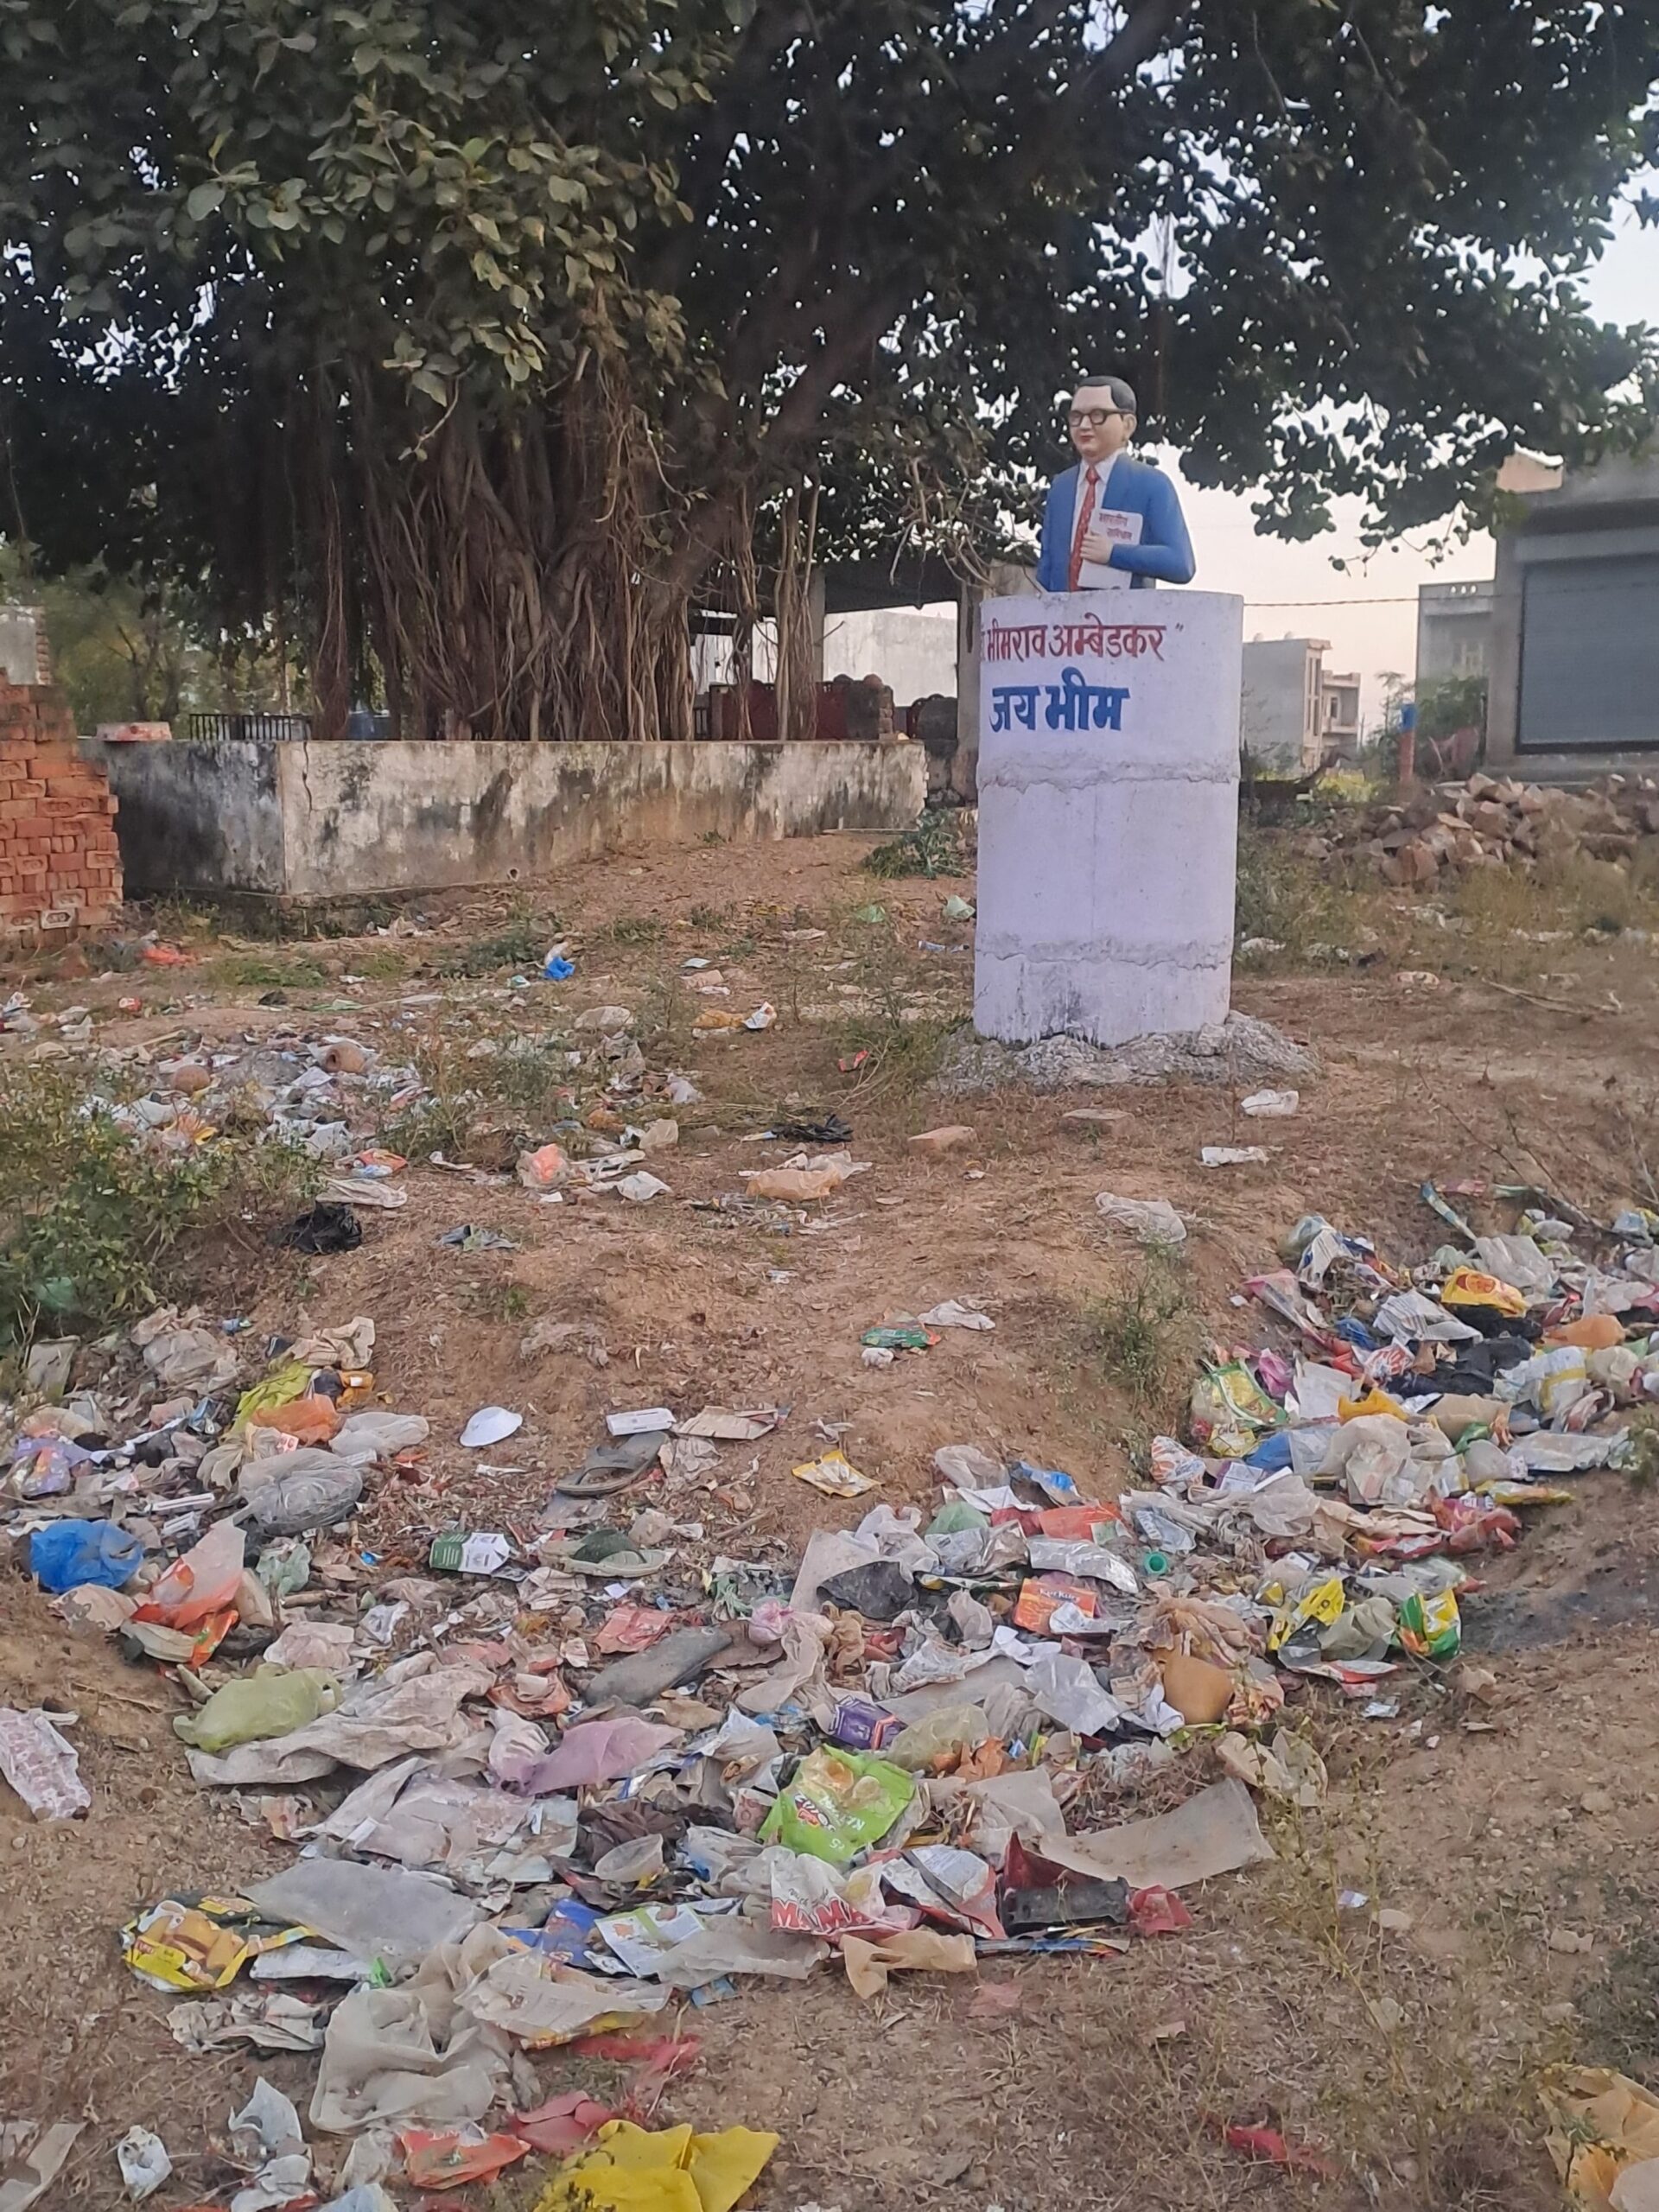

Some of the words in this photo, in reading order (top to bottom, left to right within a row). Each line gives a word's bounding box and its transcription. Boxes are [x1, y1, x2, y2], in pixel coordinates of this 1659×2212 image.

[987, 618, 1048, 663] भीमराव
[989, 686, 1040, 732] जय
[1045, 666, 1130, 732] भीम
